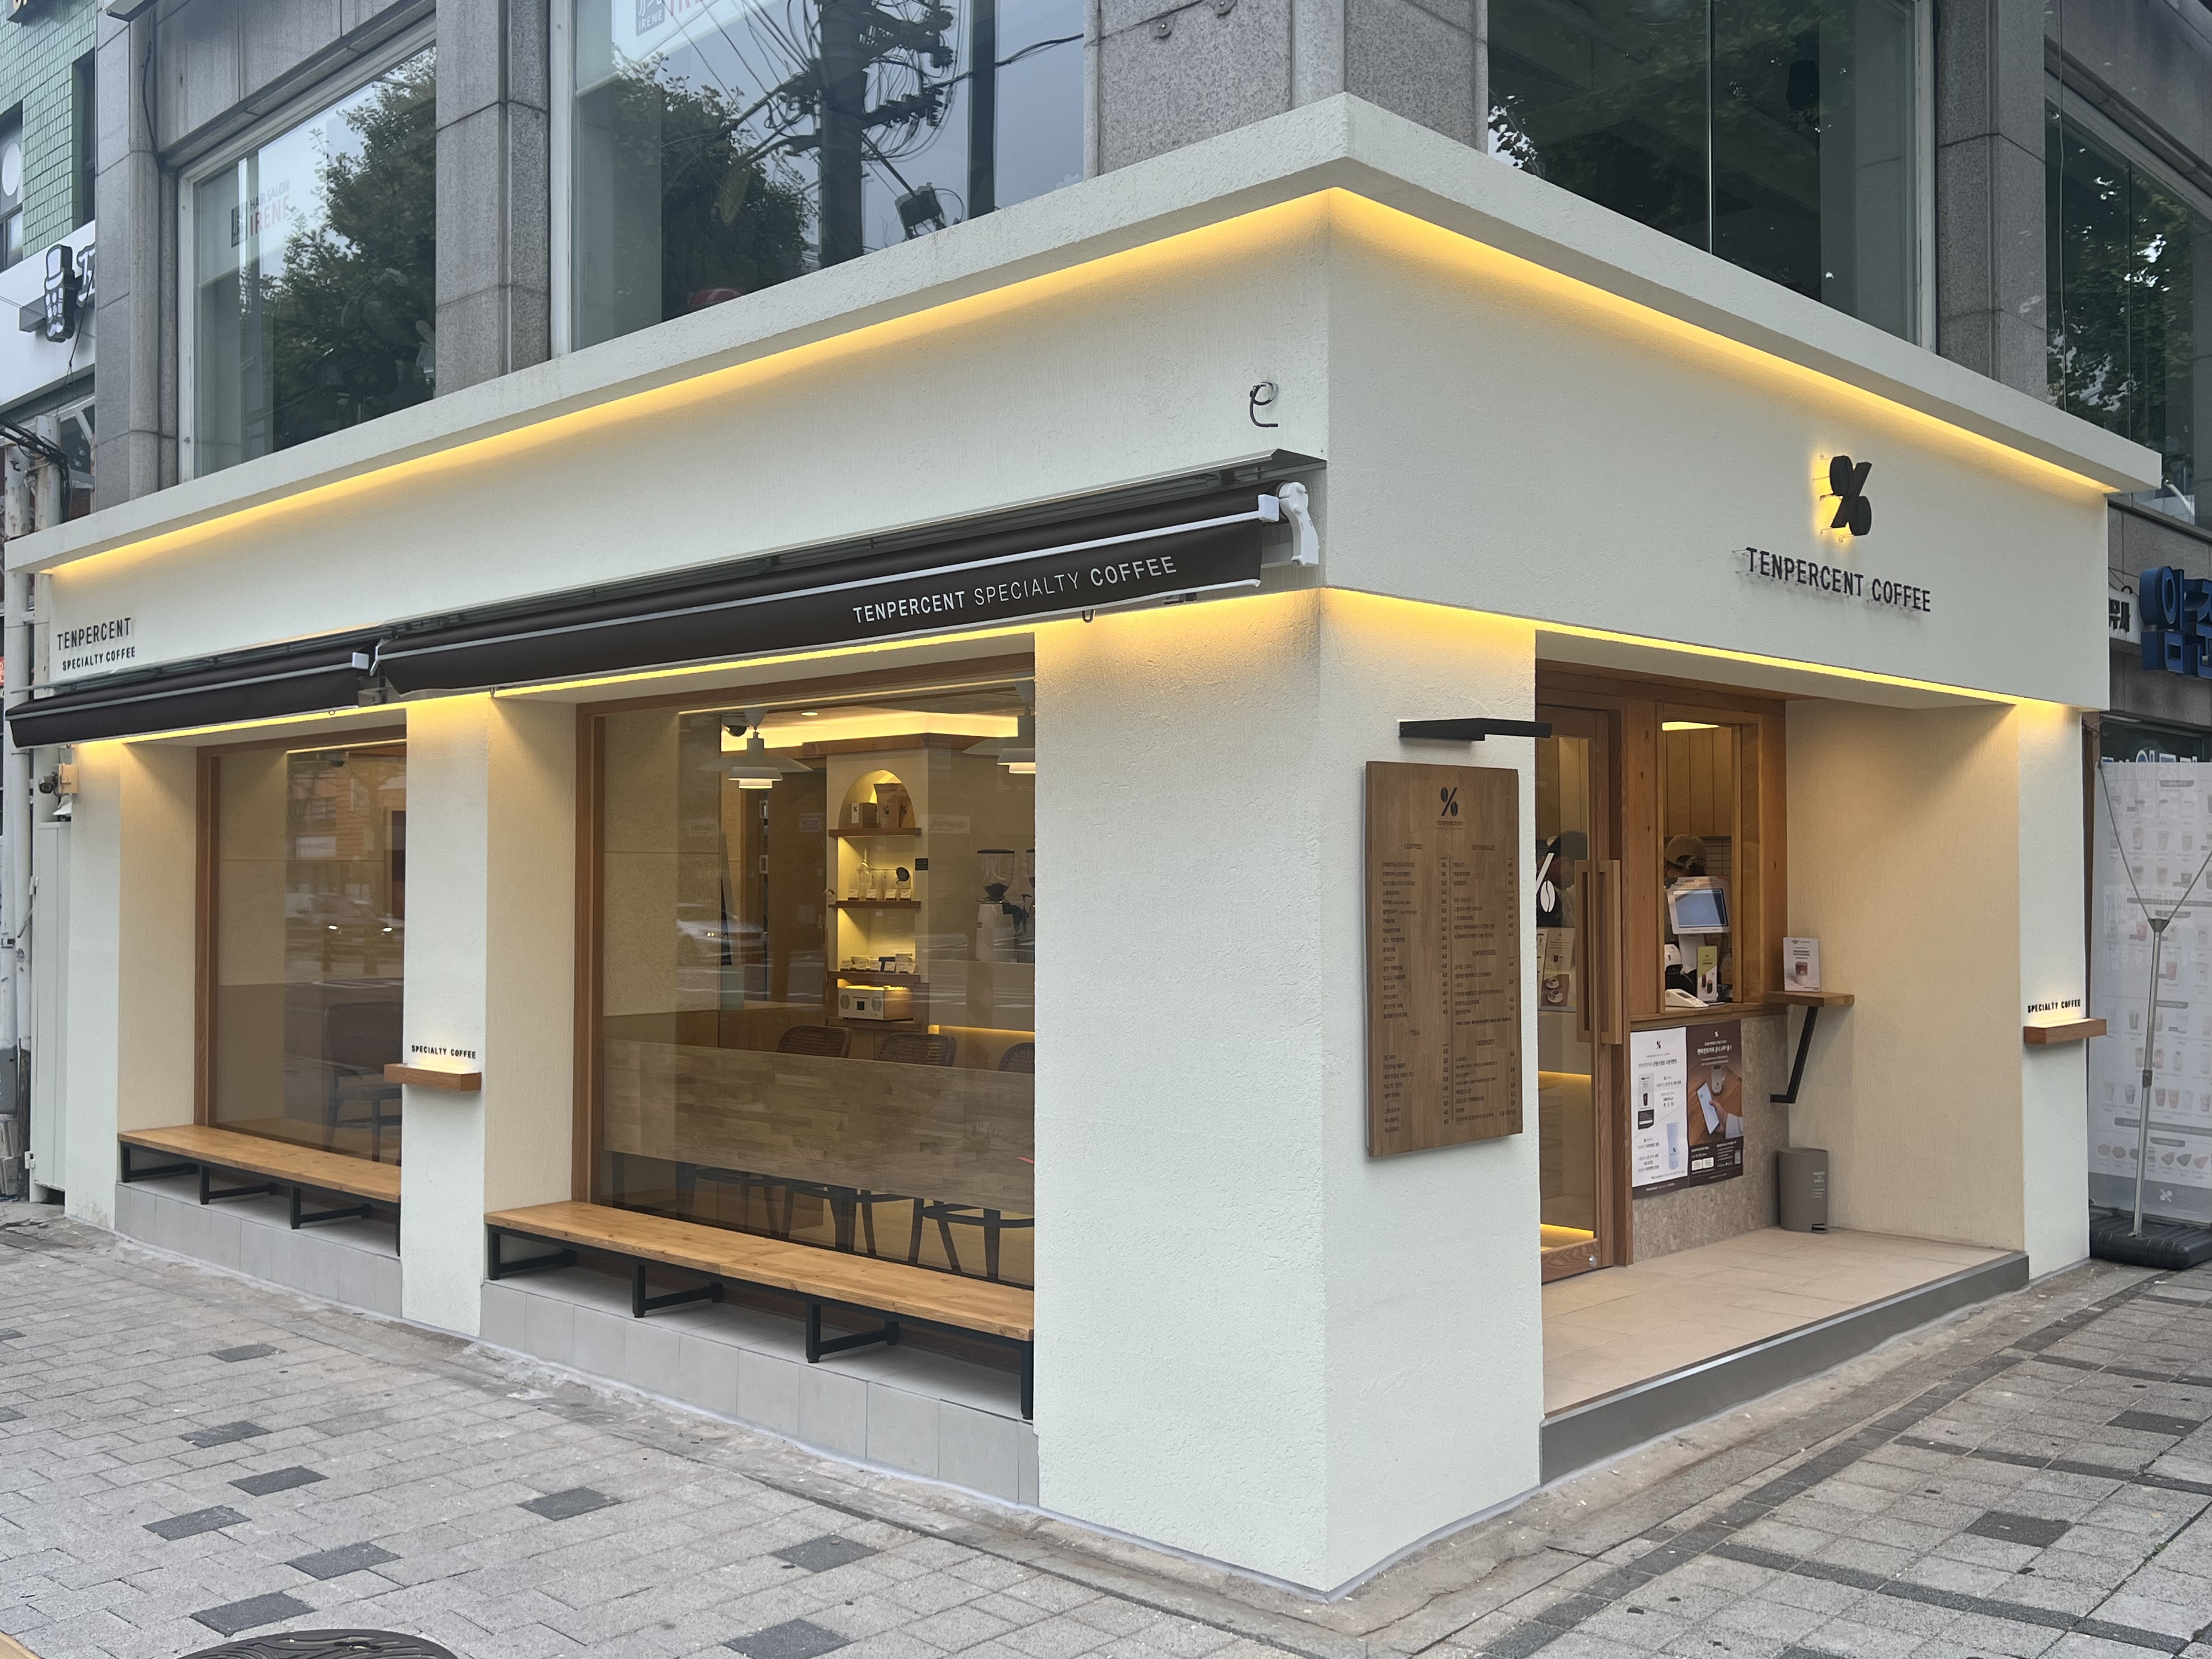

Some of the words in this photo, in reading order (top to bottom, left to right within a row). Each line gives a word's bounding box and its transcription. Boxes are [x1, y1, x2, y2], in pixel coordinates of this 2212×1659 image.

[267, 179, 290, 202] SALON
[250, 195, 290, 237] IRENE
[853, 590, 966, 624] TENPERCENT
[974, 572, 1079, 606] SPECIALTY
[1089, 556, 1177, 586] COFFEE
[1745, 546, 1864, 597] TENPERCENT
[1871, 578, 1931, 612] COFFEE
[57, 617, 131, 651] TENPERCENT
[63, 653, 104, 672] SPECIALTY
[106, 646, 136, 662] COFFEE
[2028, 1002, 2058, 1013] SPECIALTY
[2061, 999, 2081, 1008] COFFEE
[411, 1045, 447, 1055] SPECIALTY
[451, 1048, 476, 1059] COFFEE
